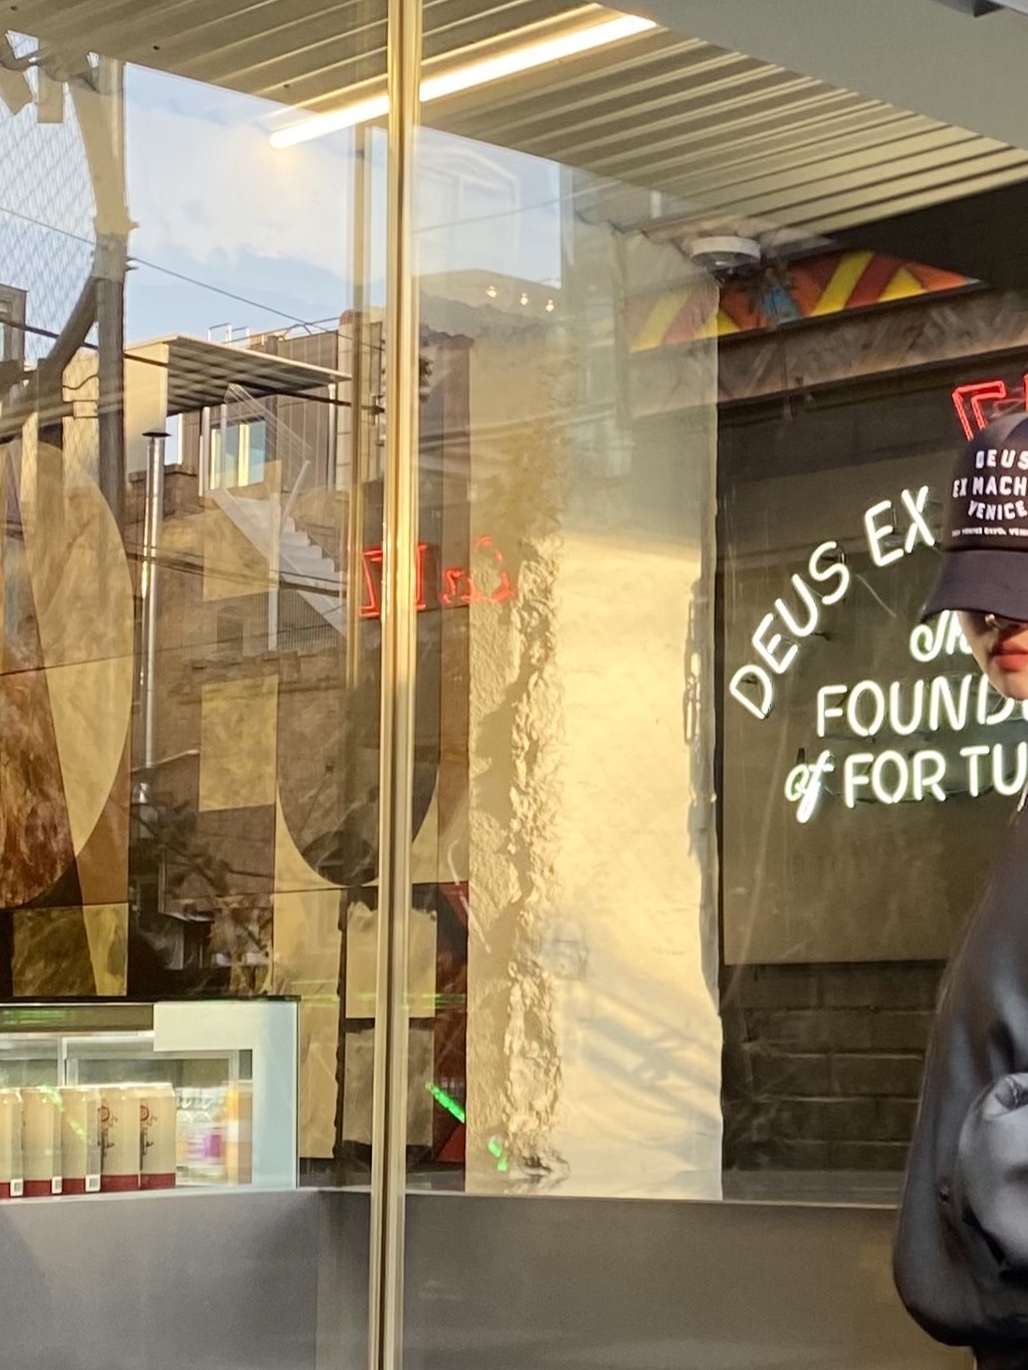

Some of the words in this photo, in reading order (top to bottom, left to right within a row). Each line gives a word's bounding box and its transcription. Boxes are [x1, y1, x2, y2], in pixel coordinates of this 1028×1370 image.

[952, 479, 967, 498] EX
[967, 500, 1028, 521] VENICE
[729, 540, 850, 719] DEUS
[864, 485, 935, 567] EX
[784, 750, 834, 823] of
